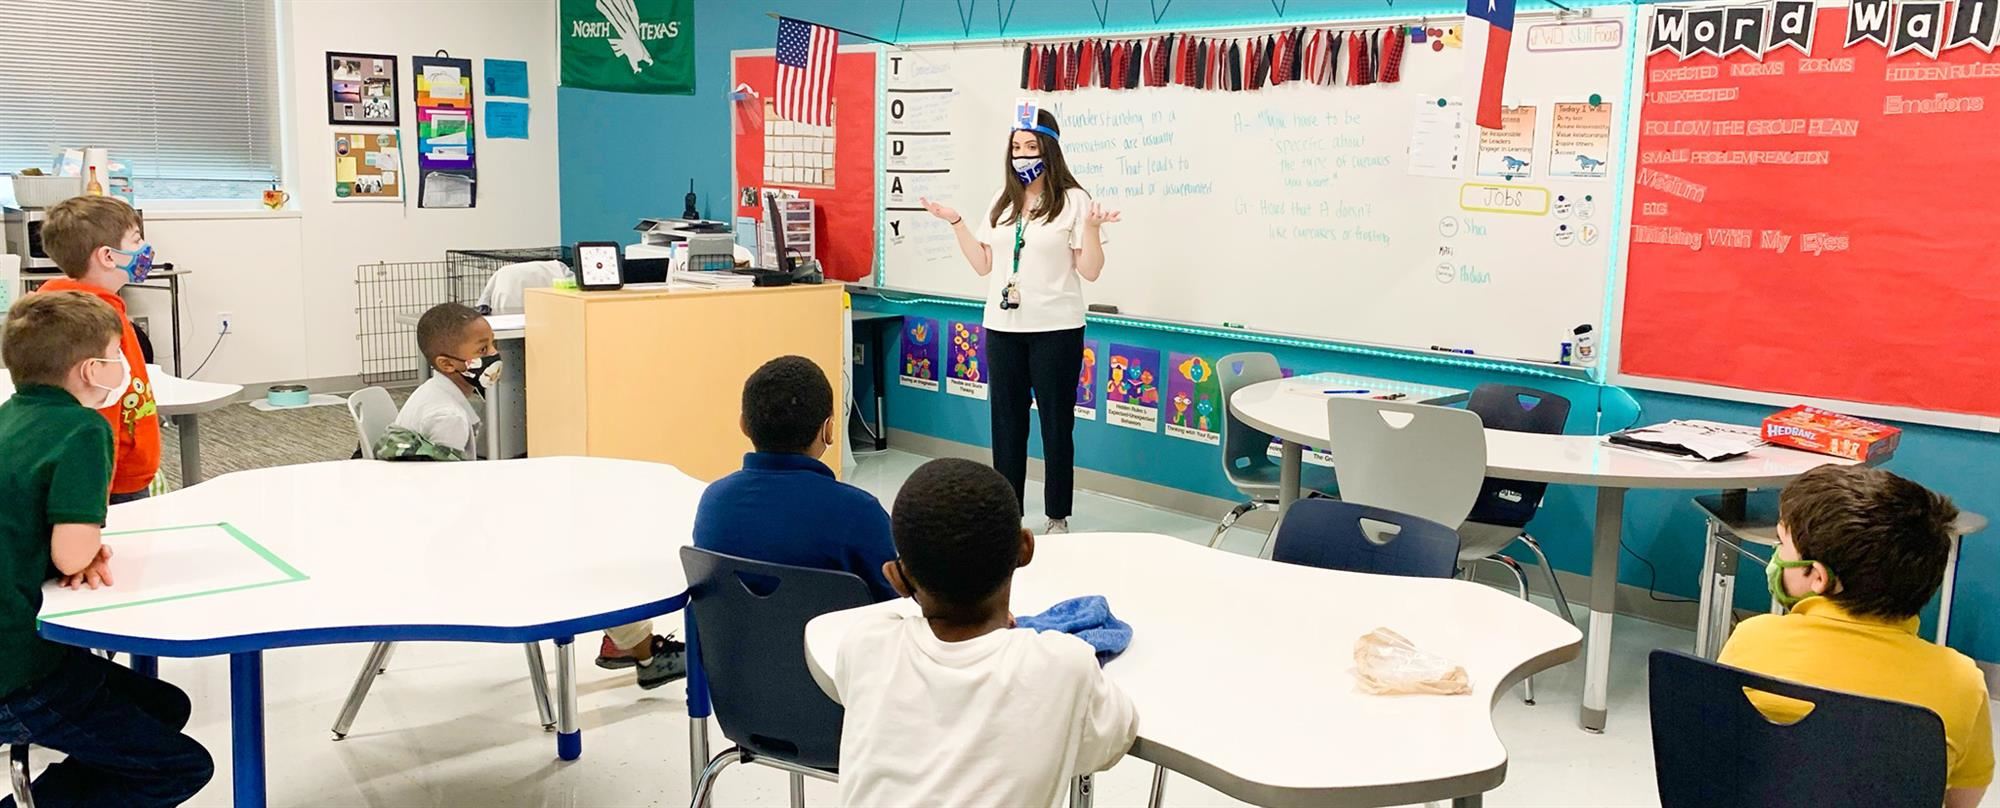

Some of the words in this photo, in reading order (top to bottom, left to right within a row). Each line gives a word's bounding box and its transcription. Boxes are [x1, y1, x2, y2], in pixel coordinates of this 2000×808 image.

[571, 20, 610, 38] NORTH
[639, 21, 679, 40] TEXAS
[1657, 9, 1806, 42] Word
[1652, 66, 1717, 81] EXPECTED
[1732, 63, 1783, 76] NORMS
[1886, 67, 1948, 81] HIDDEN
[1559, 105, 1580, 115] Today
[1884, 94, 1983, 114] Emotions
[1326, 112, 1337, 126] to
[1344, 111, 1361, 125] be
[1645, 121, 1710, 135] FOLLOW
[1713, 121, 1744, 135] THE
[1748, 120, 1804, 135] GROUP
[1808, 120, 1858, 136] PLAN
[1123, 138, 1138, 149] are
[1336, 155, 1346, 168] of
[1642, 151, 1687, 163] SMALL
[1116, 156, 1142, 175] That
[1147, 157, 1173, 173] leads
[1178, 156, 1189, 170] to
[1637, 168, 1706, 202] Medium
[1643, 203, 1666, 215] BIG
[1708, 229, 1752, 247] With
[1761, 230, 1790, 252] My
[1802, 233, 1848, 255] Eyes
[1077, 407, 1090, 415] Group
[1132, 406, 1143, 414] Rules
[1167, 425, 1185, 435] Thinking
[1207, 433, 1218, 441] Eyes
[1767, 423, 1817, 441] HEDBANZ
